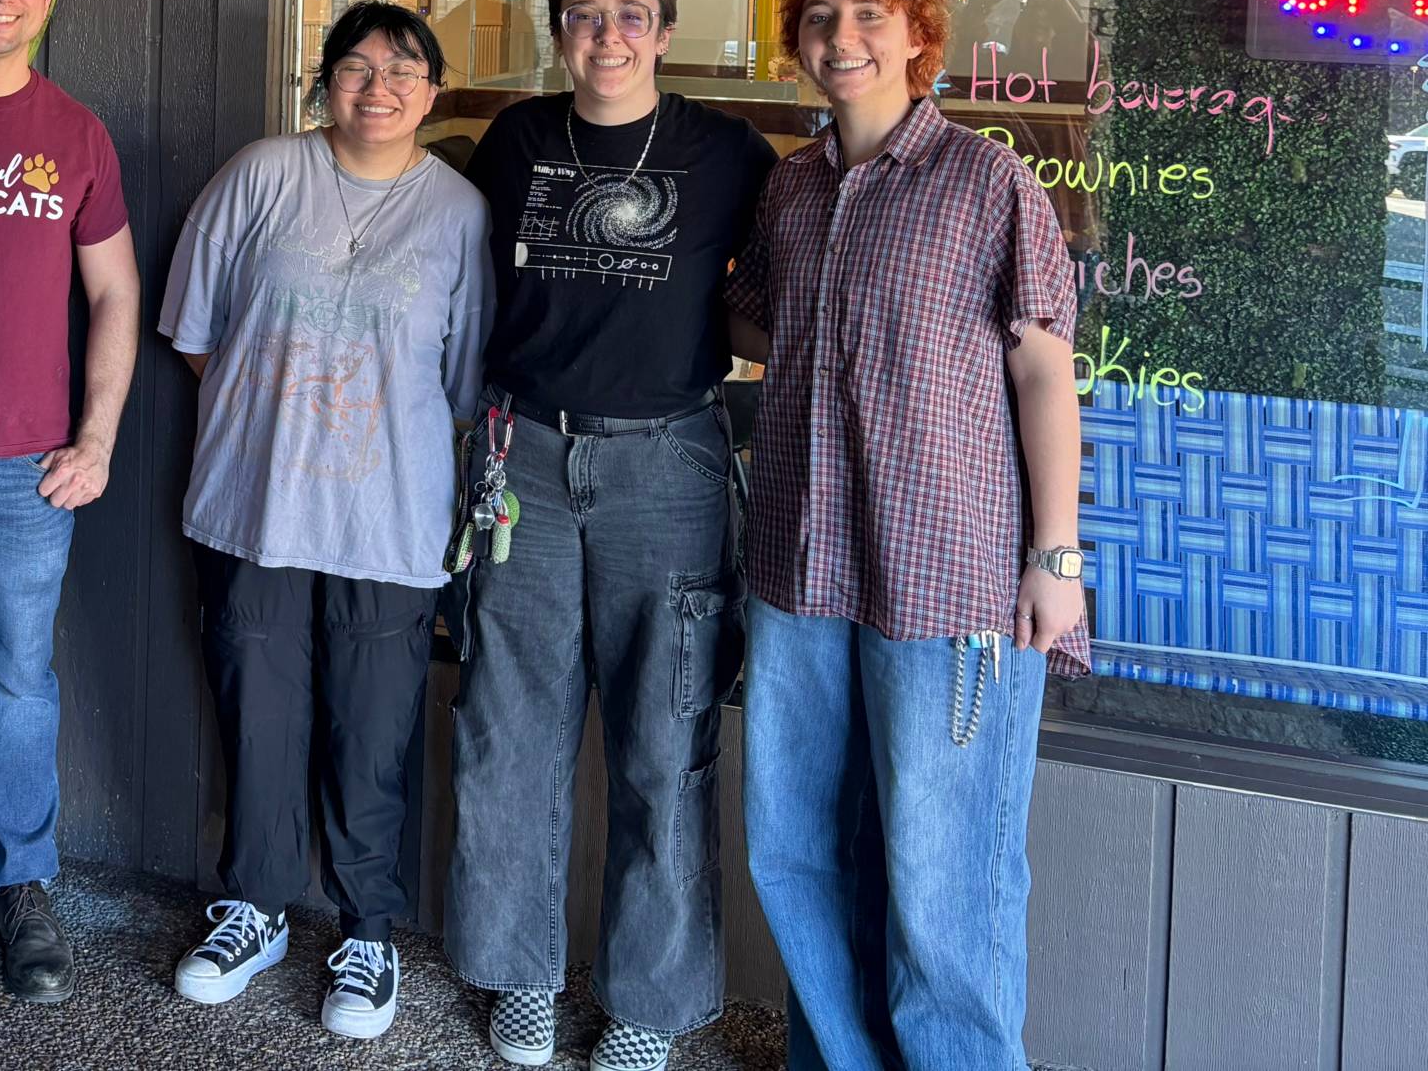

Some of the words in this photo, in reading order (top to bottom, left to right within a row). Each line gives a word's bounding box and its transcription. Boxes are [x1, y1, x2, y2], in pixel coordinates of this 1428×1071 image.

[971, 41, 1057, 104] Hot
[533, 164, 557, 176] Milky
[557, 167, 577, 177] Way
